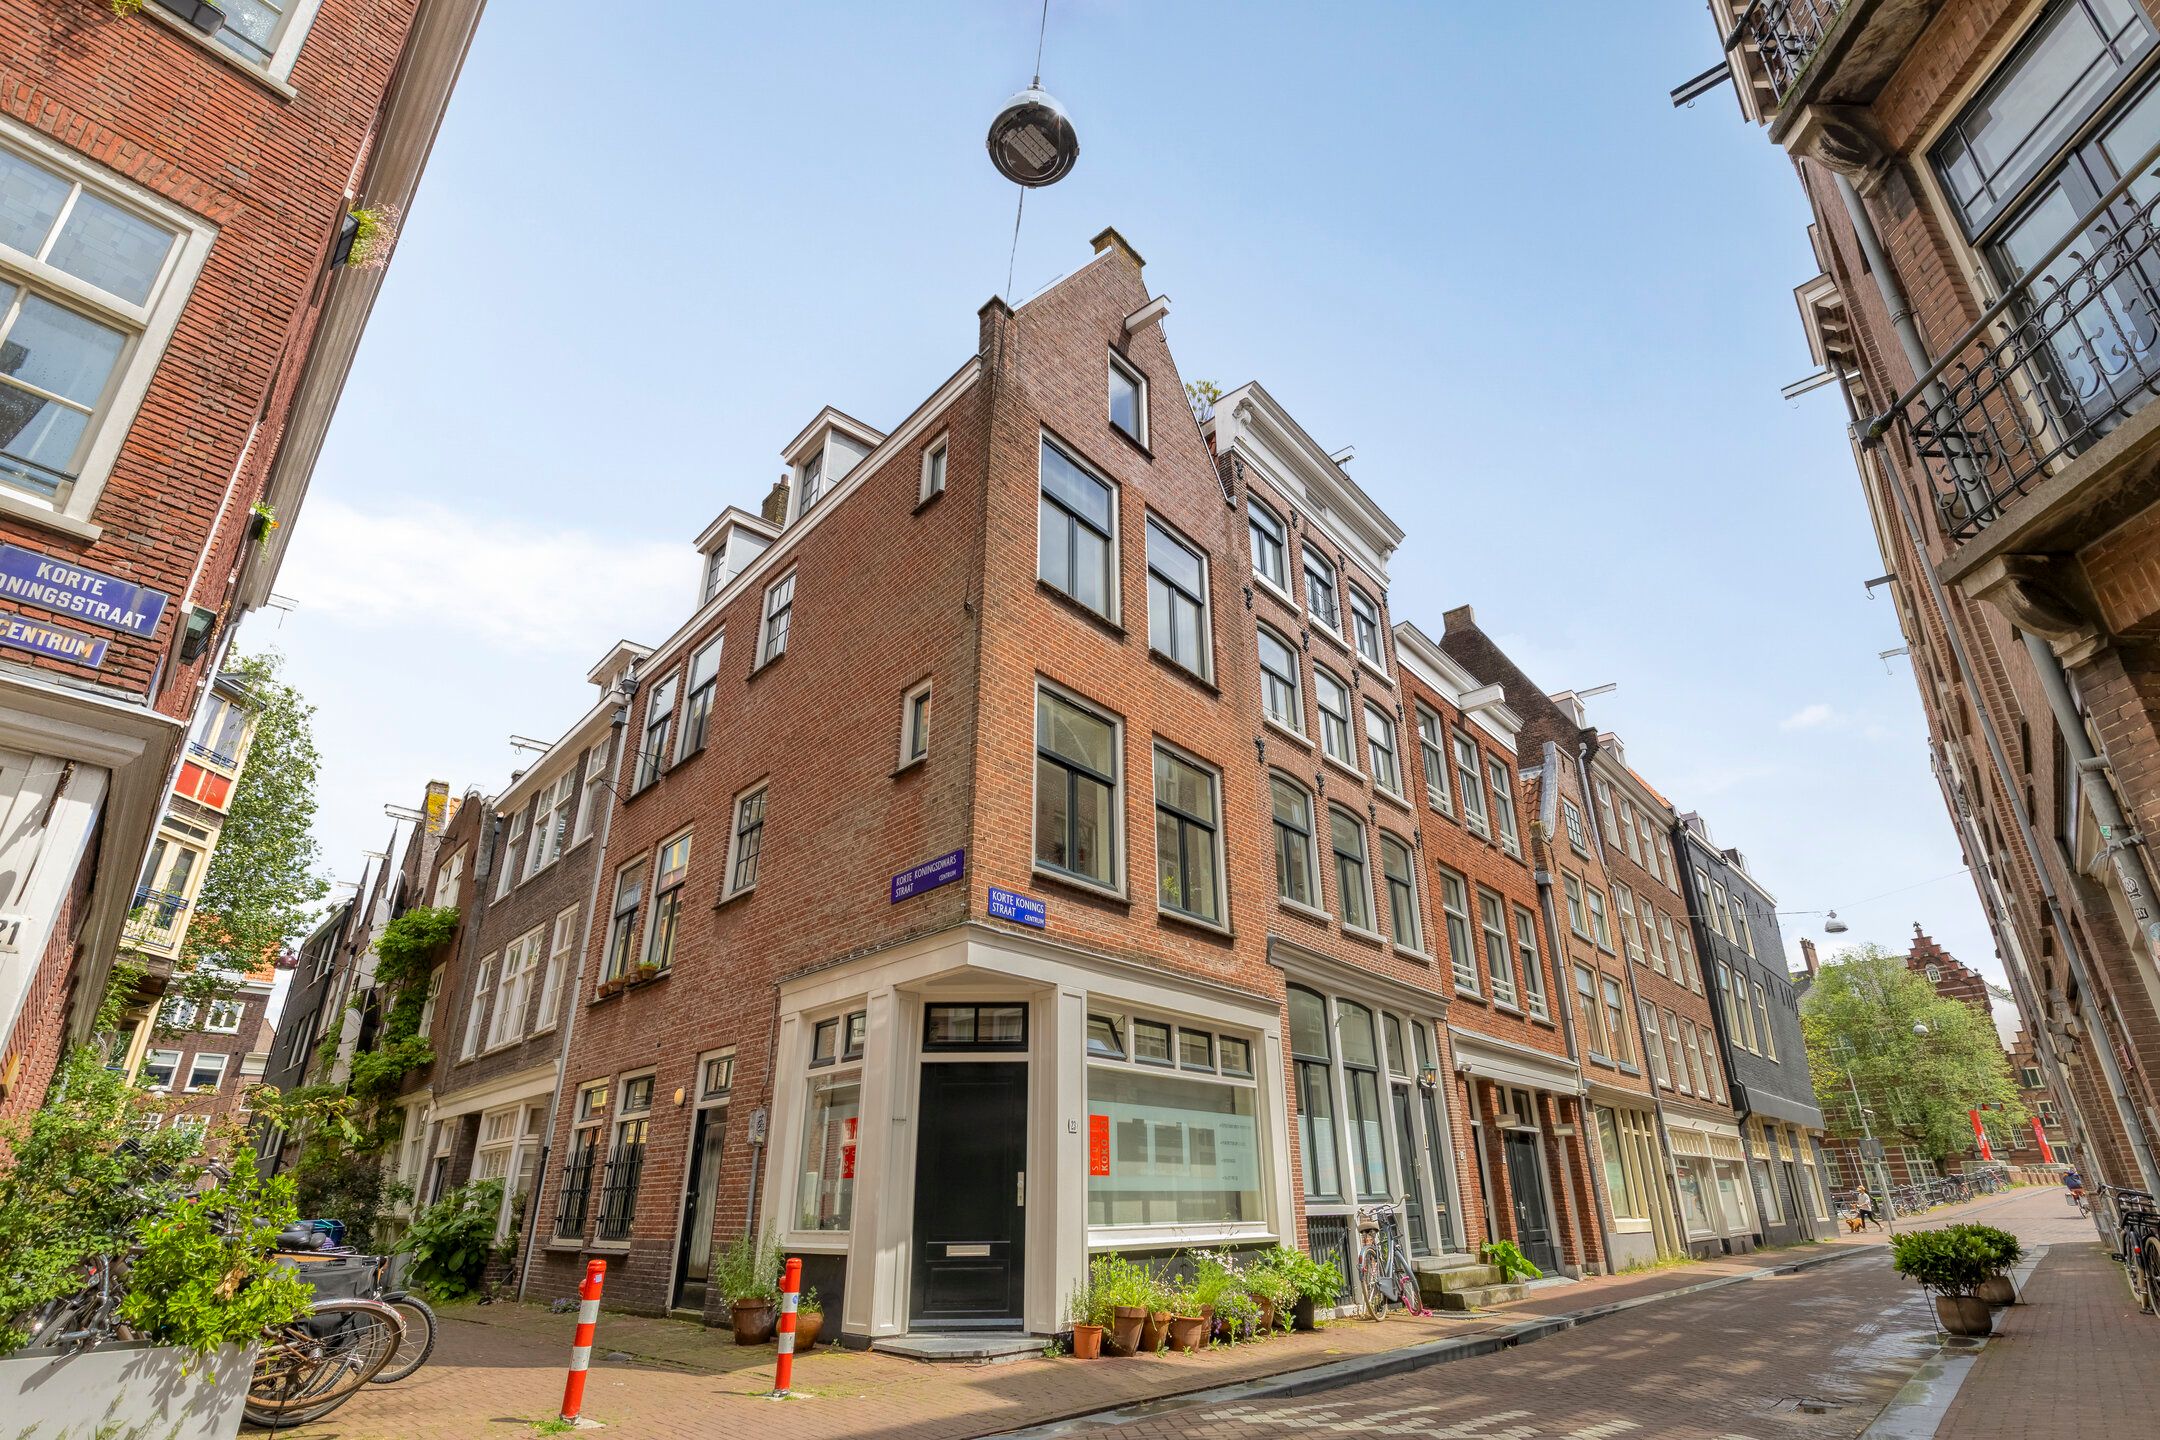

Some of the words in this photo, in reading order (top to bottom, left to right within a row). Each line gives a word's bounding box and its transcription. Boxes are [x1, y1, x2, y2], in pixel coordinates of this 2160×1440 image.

[36, 562, 107, 596] KORTE
[0, 618, 95, 658] CENTRUM
[896, 872, 913, 887] KORTE
[914, 854, 957, 880] KONINGSDWARS
[938, 870, 957, 881] CENTRUM
[895, 882, 914, 898] STRAAT
[992, 890, 1014, 906] KORTE
[1015, 897, 1045, 914] KONINGS
[992, 902, 1016, 917] STRAAT
[1024, 914, 1045, 925] CENTRUM
